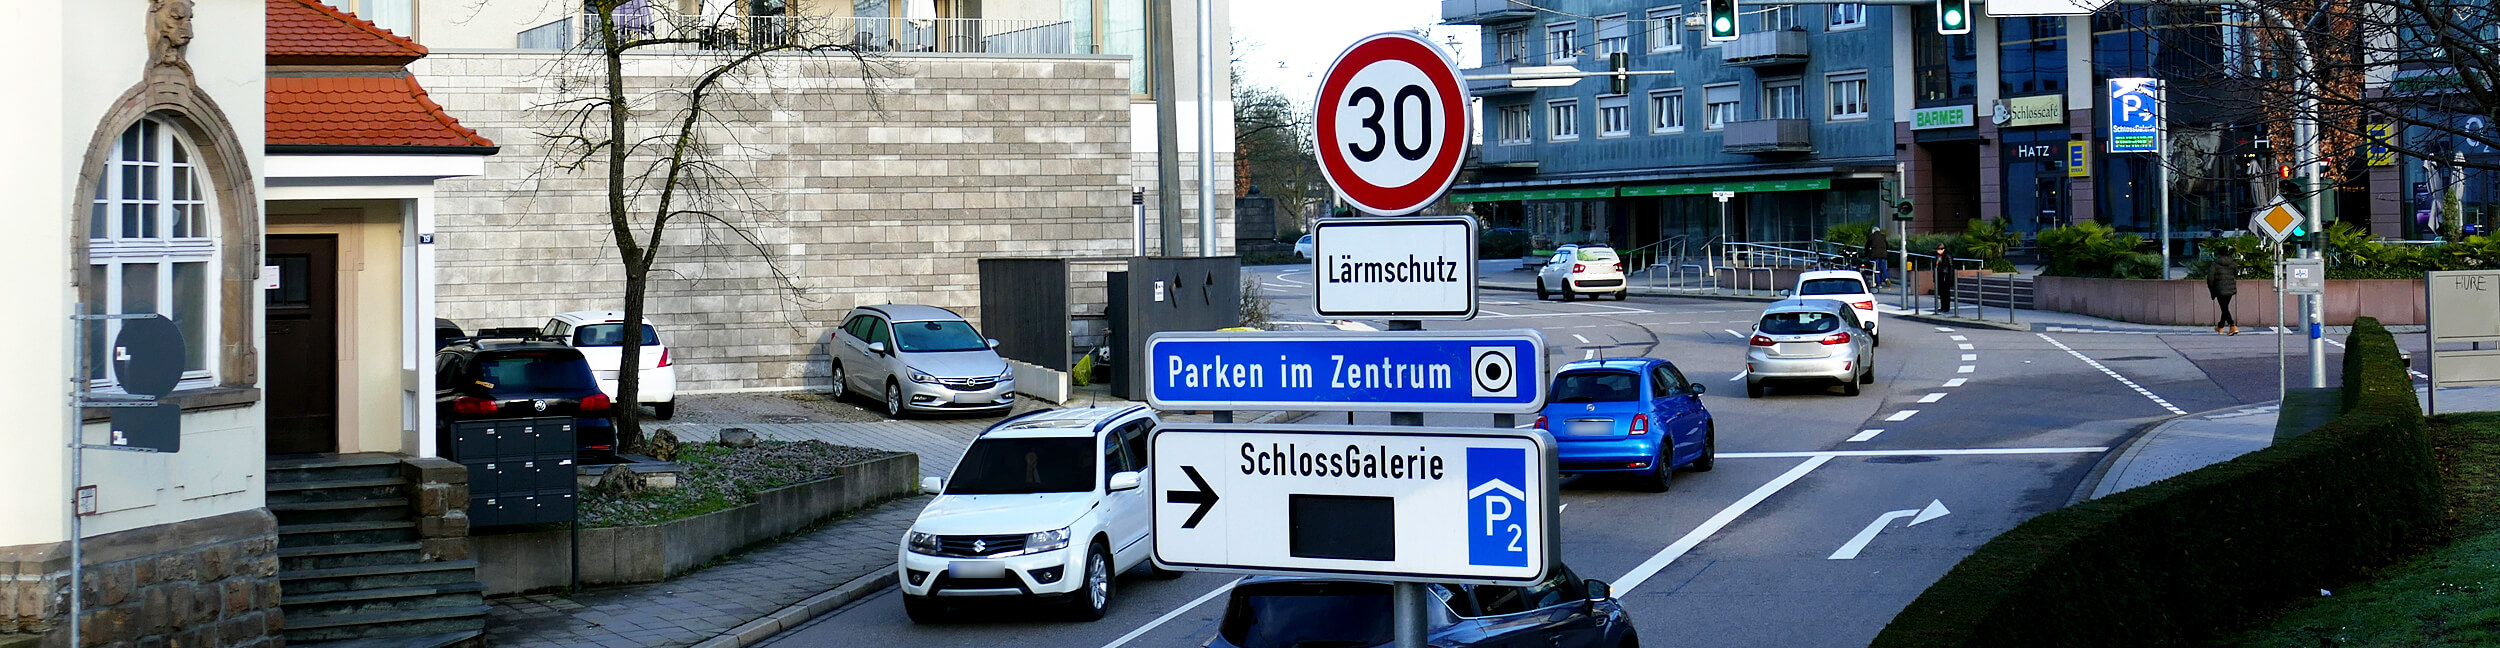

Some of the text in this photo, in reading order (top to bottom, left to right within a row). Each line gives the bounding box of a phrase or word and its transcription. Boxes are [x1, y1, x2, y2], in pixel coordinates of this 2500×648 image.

[1916, 109, 1964, 127] BARMER
[2011, 103, 2058, 121] Schlosscafé
[1348, 84, 1432, 162] 30
[2018, 145, 2049, 158] HATZ
[2071, 145, 2082, 166] E
[423, 234, 431, 243] 19
[1328, 253, 1458, 284] Lärmschutz
[2455, 275, 2487, 291] HURE
[1168, 354, 1452, 389] Parken im Zentrum
[1240, 441, 1445, 481] SchlossGalerie
